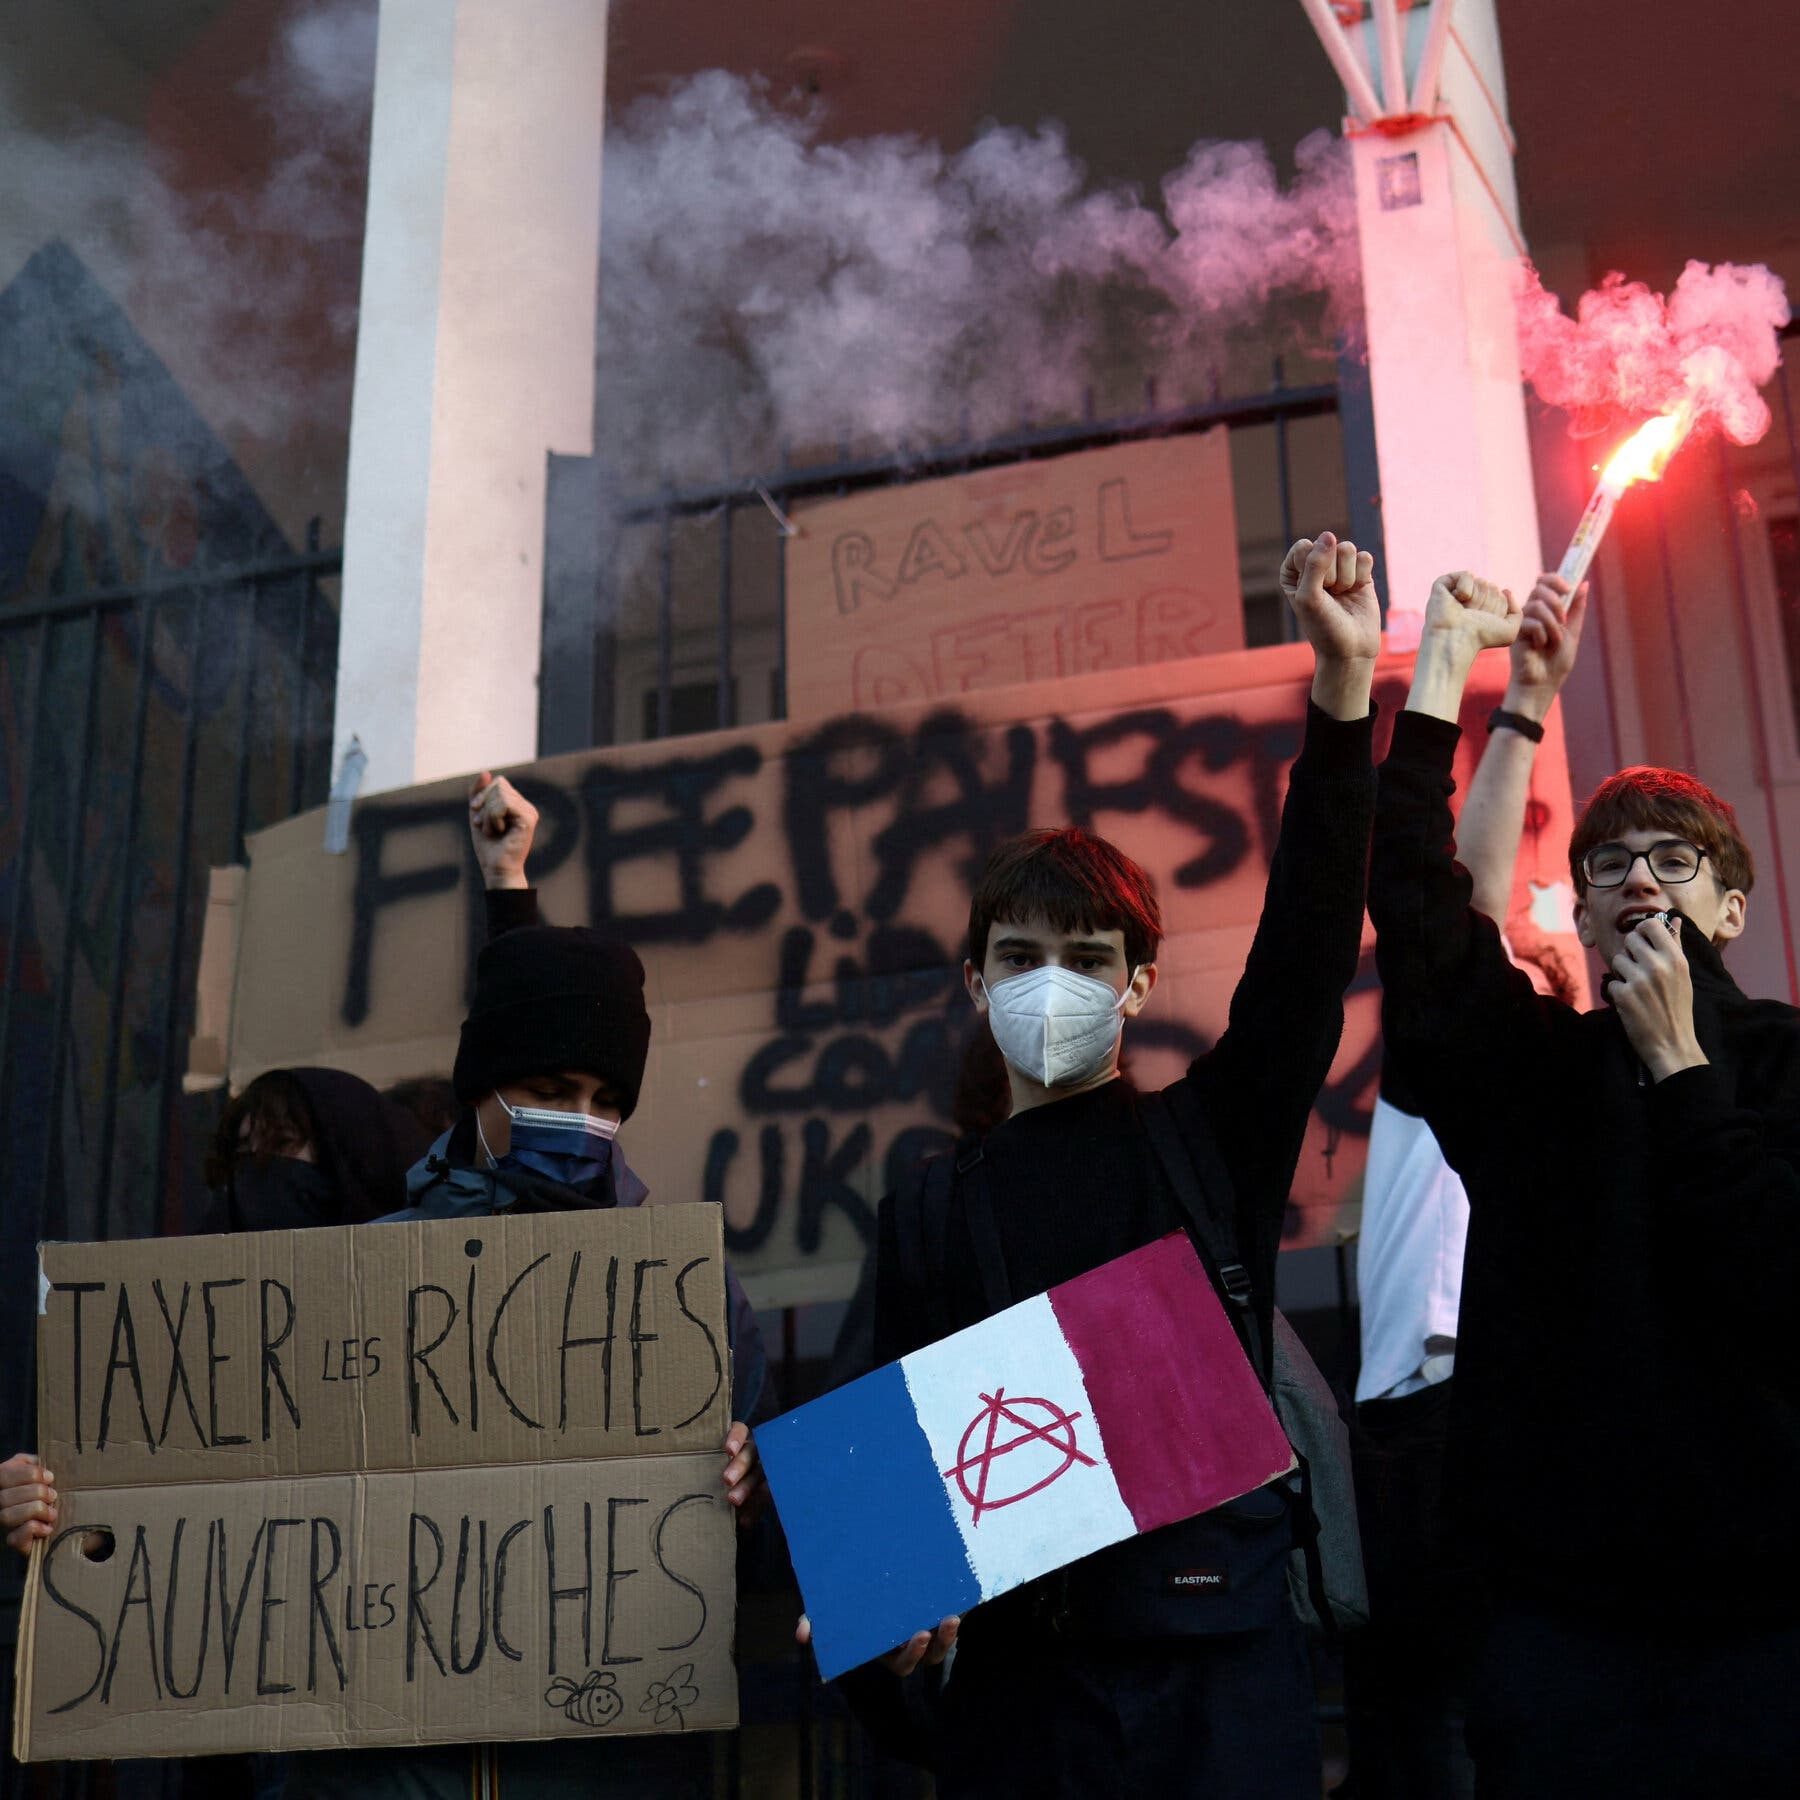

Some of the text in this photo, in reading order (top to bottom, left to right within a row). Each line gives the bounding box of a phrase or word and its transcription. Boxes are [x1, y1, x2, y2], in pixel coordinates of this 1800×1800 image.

[342, 744, 782, 1027] FREE
[51, 1277, 301, 1455] TAXER
[320, 1336, 382, 1382] LES
[42, 1493, 715, 1715] SAUVER LES RUCHES
[1174, 1575, 1221, 1585] EASTPAK
